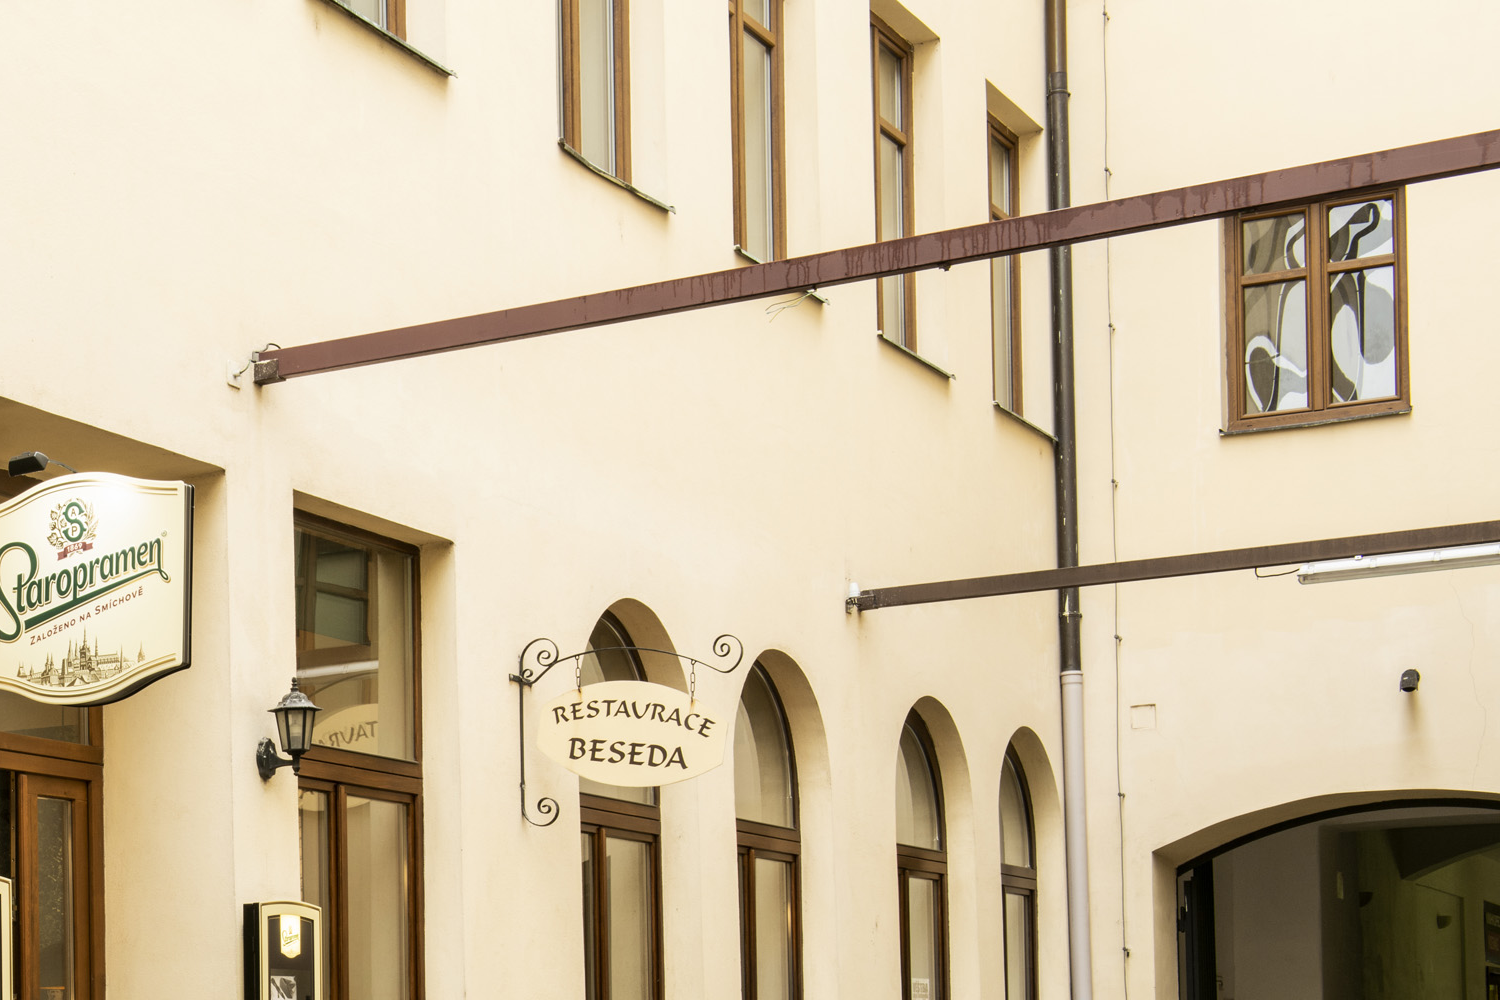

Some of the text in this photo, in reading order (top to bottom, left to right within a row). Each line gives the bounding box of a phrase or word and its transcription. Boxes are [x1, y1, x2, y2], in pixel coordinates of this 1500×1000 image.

[66, 542, 83, 552] 1869
[80, 612, 92, 624] NA
[552, 698, 716, 738] RESTAURACE
[568, 737, 688, 770] BESEDA
